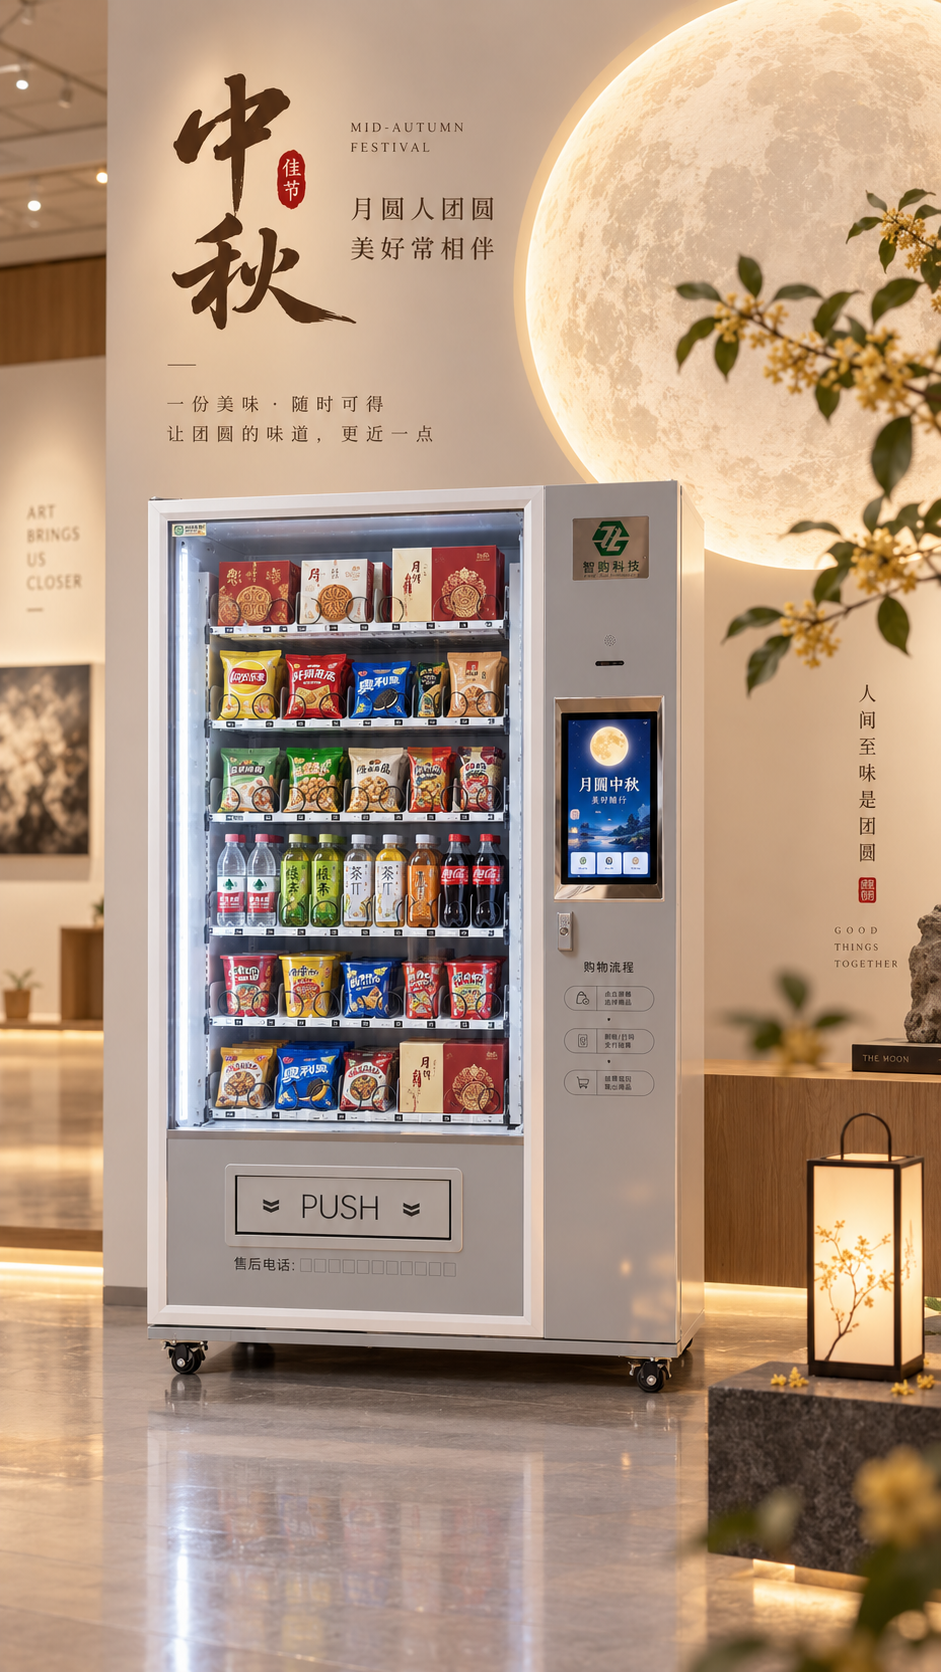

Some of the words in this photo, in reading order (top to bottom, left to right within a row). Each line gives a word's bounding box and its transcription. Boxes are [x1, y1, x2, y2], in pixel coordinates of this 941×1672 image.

[350, 121, 465, 133] MID-AUTUMN
[350, 141, 431, 153] FESTIVAL
[282, 157, 302, 202] 佳节
[171, 73, 356, 330] 中秋
[351, 196, 495, 222] 月圆人团圆
[351, 236, 495, 262] 美好常相伴
[26, 505, 55, 519] ART
[26, 527, 80, 543] BRINGS
[26, 552, 46, 567] US
[583, 560, 640, 574] 智购科技
[26, 574, 83, 591] CLOSER
[858, 684, 877, 864] 人间至味是团圆
[834, 926, 878, 935] GOOD
[834, 942, 880, 952] THINGS
[583, 961, 635, 974] 购物流程
[834, 959, 899, 969] TOGETHER
[862, 1054, 880, 1062] THE
[302, 1194, 379, 1221] PUSH
